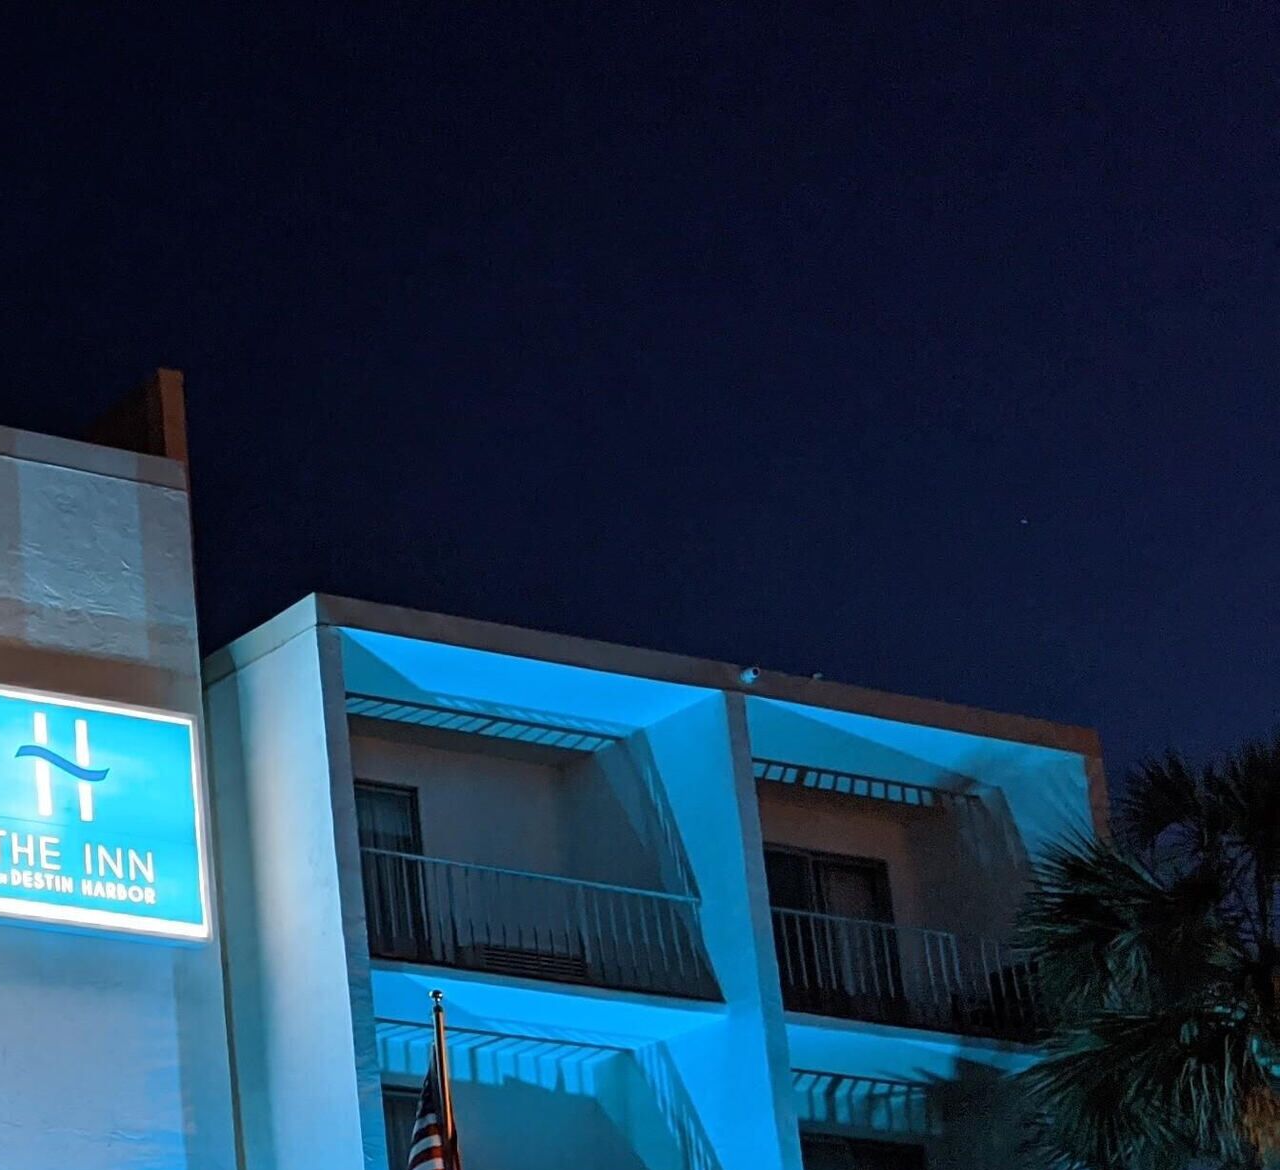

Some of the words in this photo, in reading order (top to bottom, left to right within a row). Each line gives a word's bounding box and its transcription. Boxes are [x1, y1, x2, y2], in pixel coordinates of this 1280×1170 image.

[84, 842, 155, 883] INN
[10, 868, 74, 893] DESTIN
[81, 878, 156, 905] HARBOR
